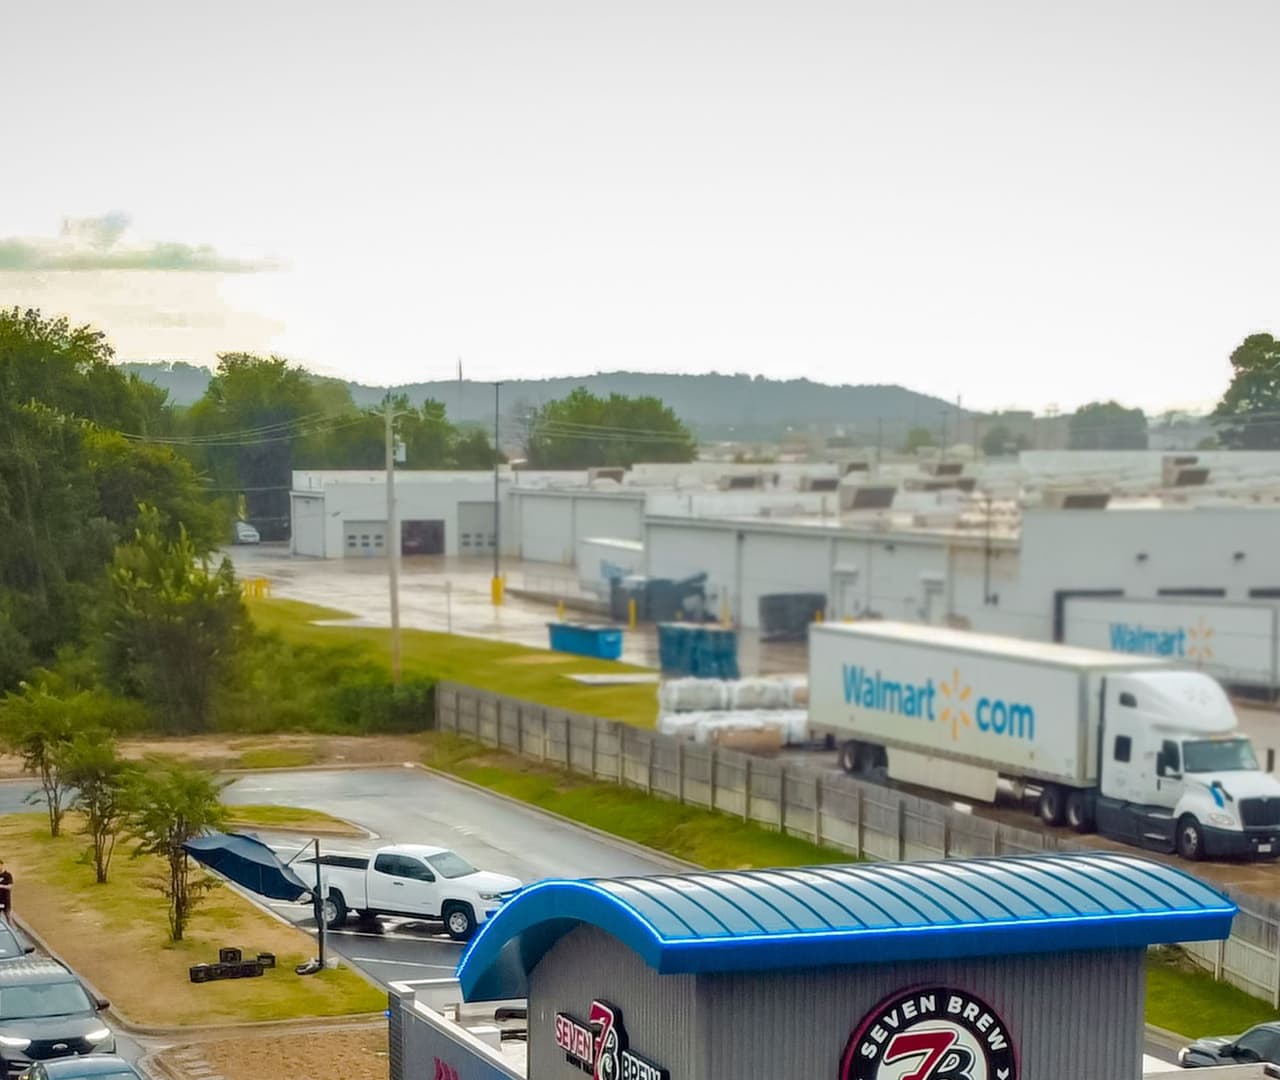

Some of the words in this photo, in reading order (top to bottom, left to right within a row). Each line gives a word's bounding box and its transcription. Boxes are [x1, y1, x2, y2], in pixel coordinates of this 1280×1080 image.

[1109, 623, 1186, 658] Walmart
[842, 664, 935, 722] Walmart
[976, 697, 1036, 740] com
[555, 1013, 593, 1065] SEVEN
[860, 994, 936, 1059] SEVEN
[947, 995, 1007, 1051] BREW
